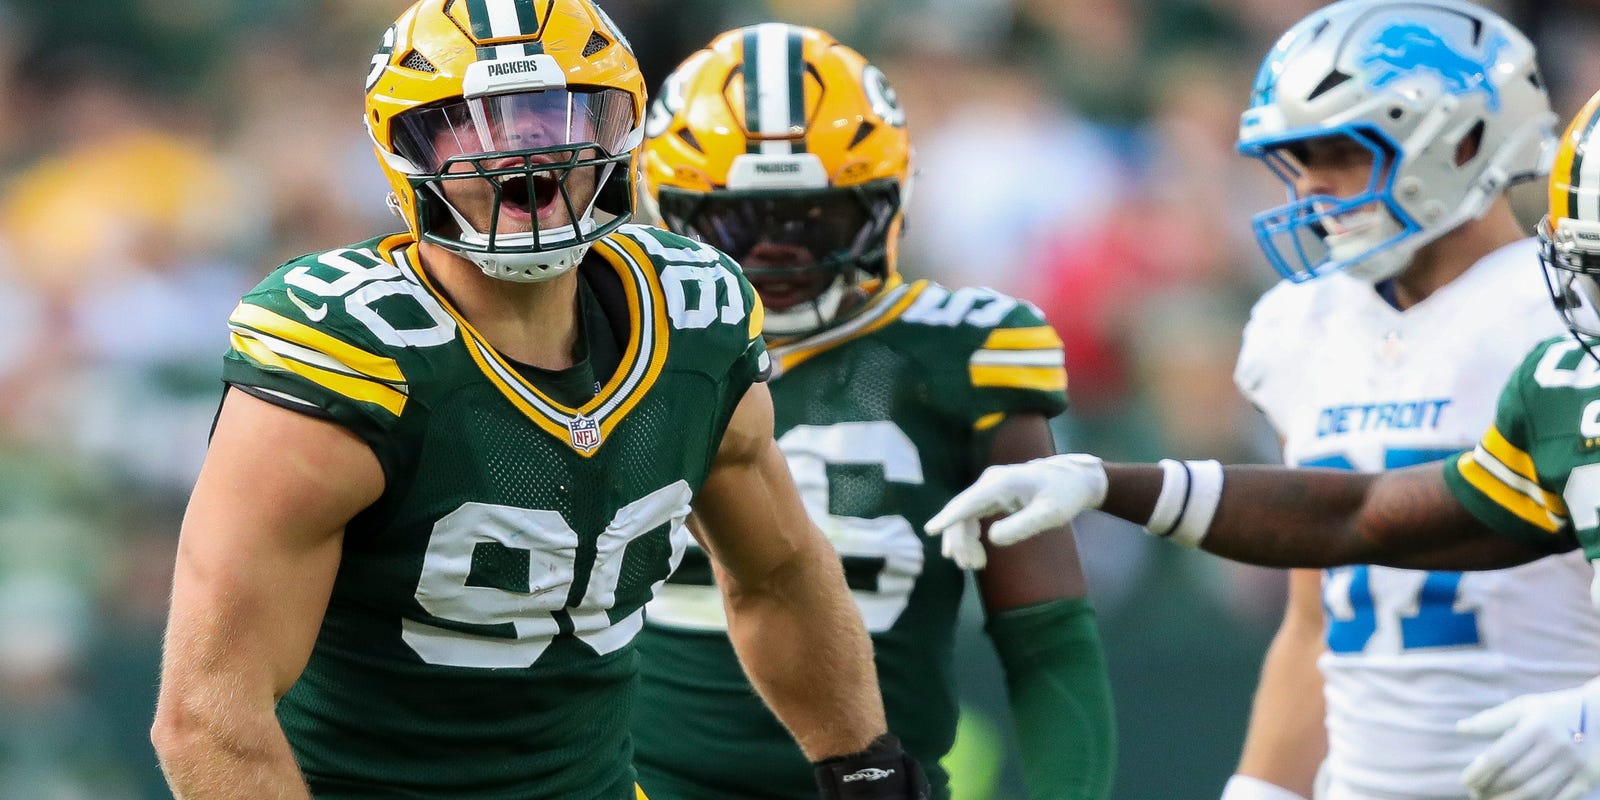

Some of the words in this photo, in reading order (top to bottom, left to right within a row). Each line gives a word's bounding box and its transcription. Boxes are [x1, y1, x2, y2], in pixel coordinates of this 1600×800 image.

[487, 60, 538, 77] PACKERS
[283, 247, 457, 348] 90
[574, 430, 597, 445] NFL
[1316, 398, 1452, 438] DETROIT
[401, 479, 693, 668] 90
